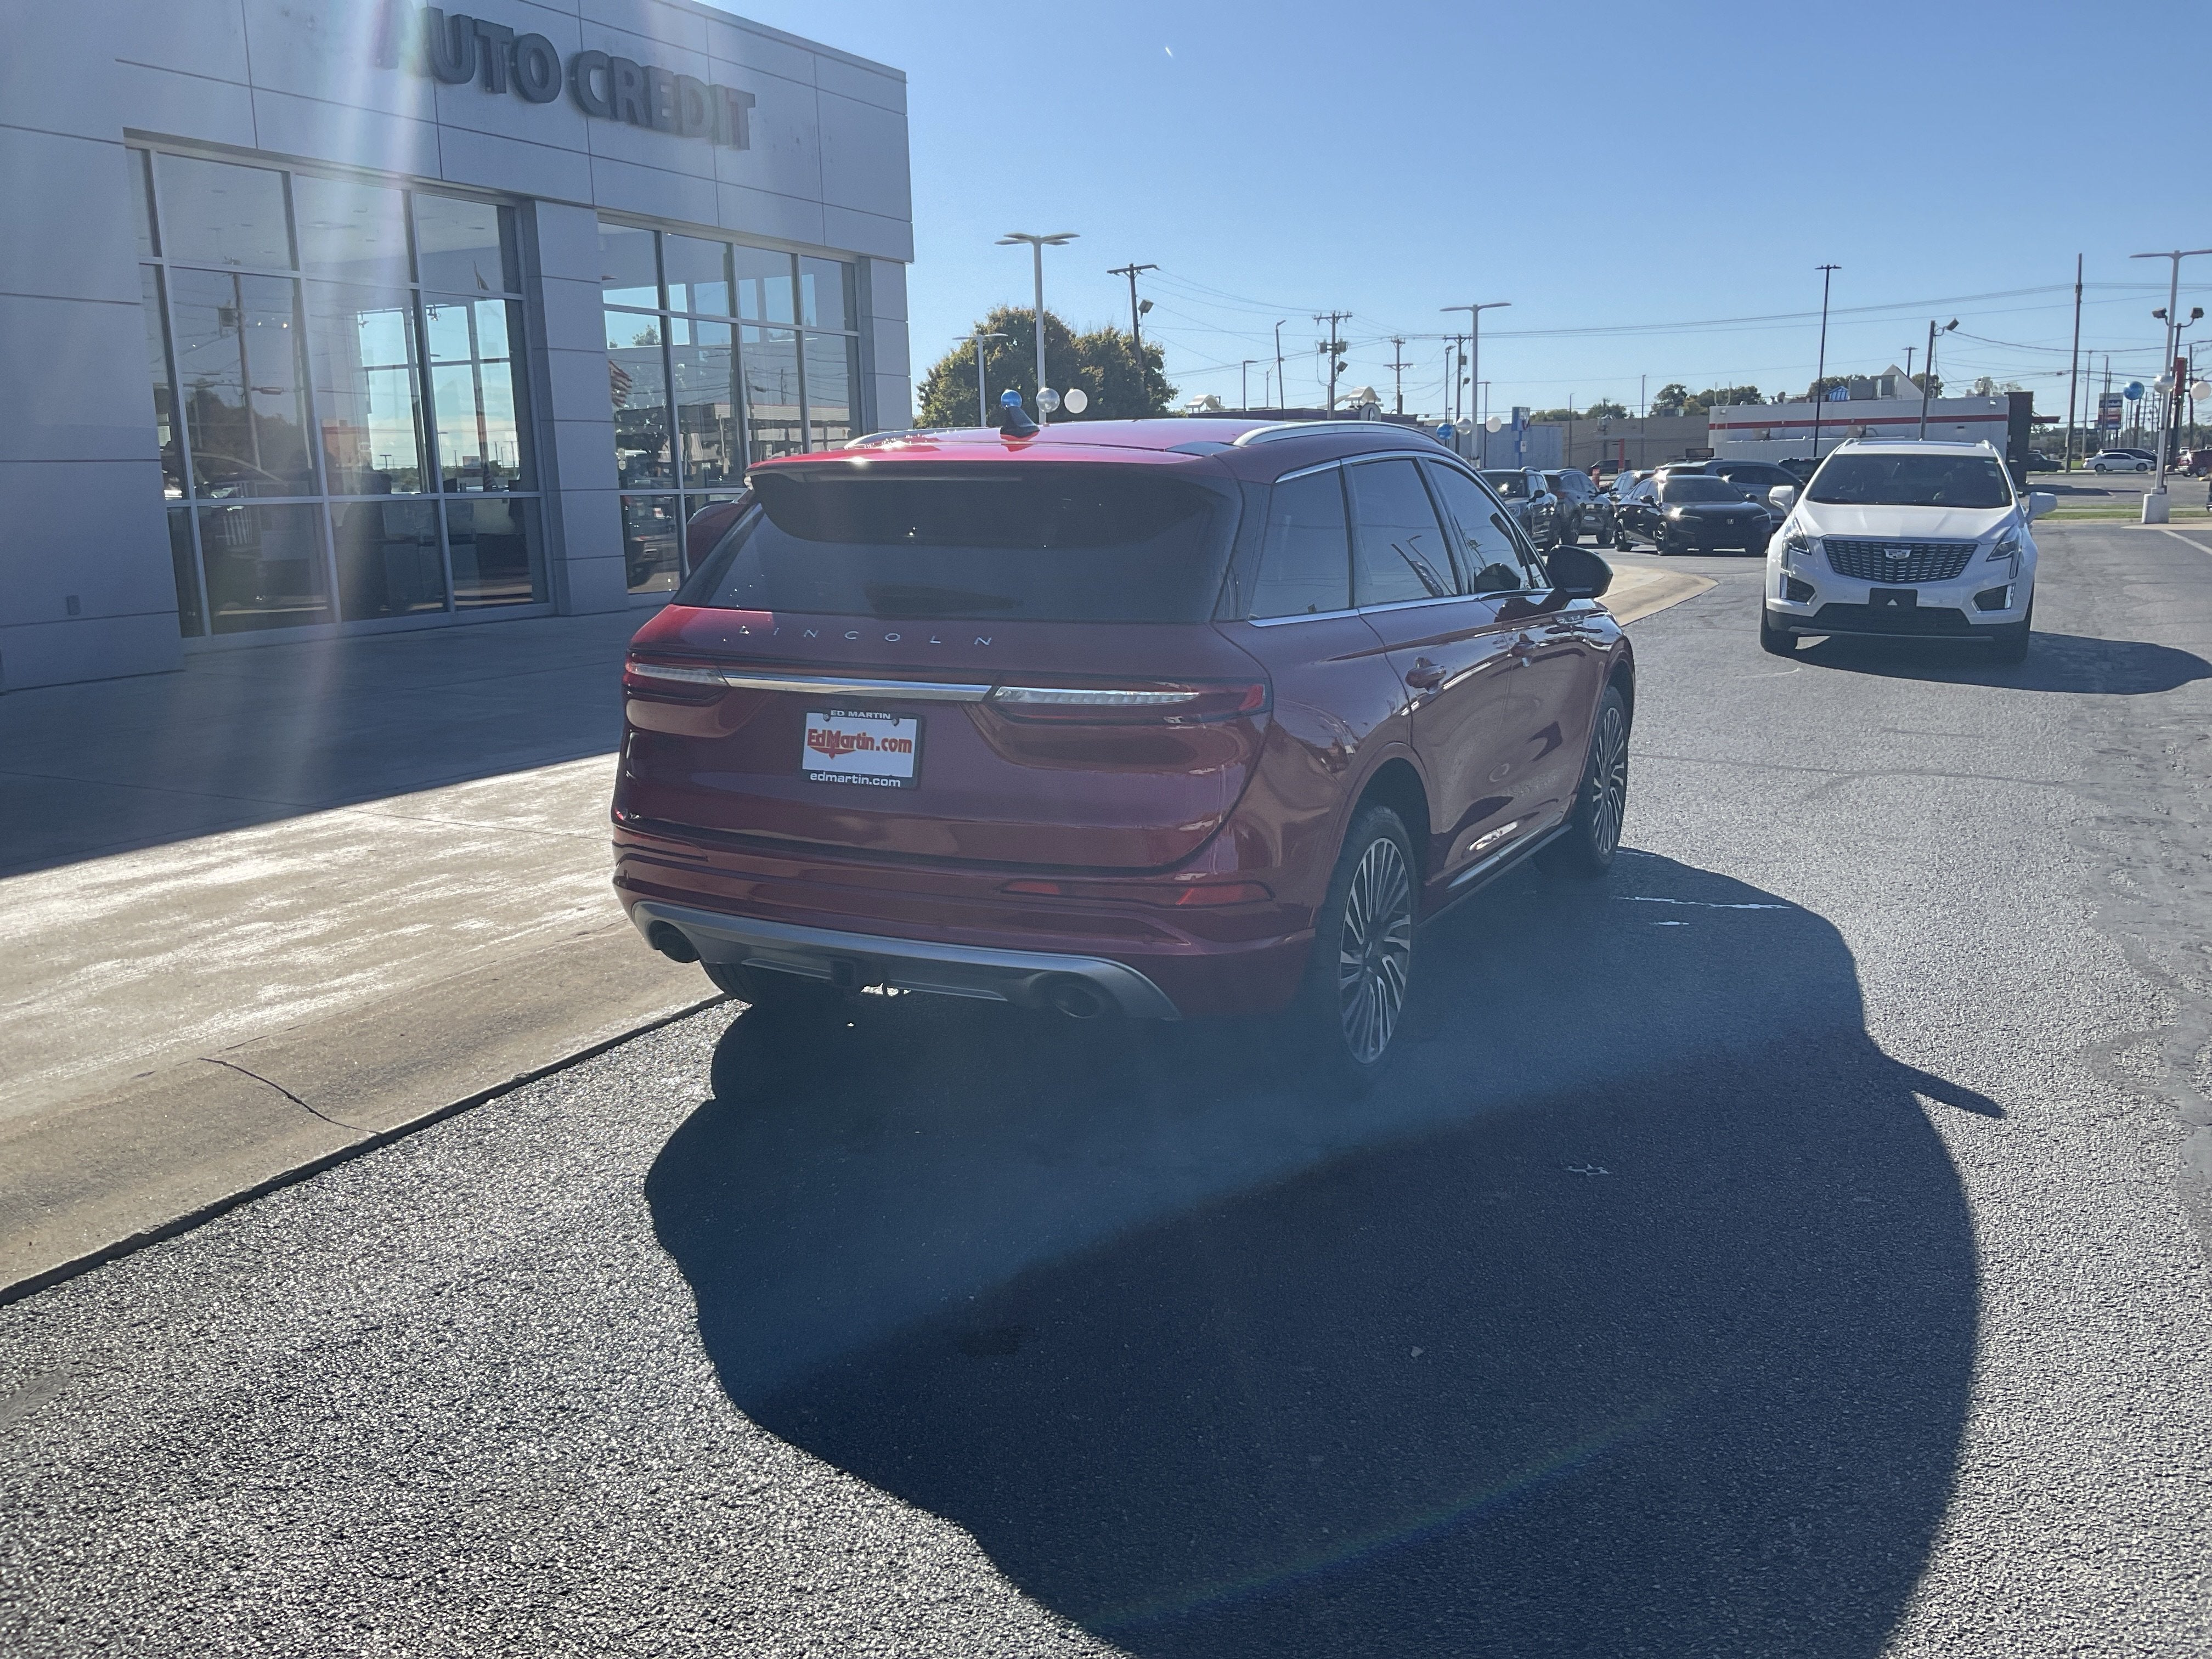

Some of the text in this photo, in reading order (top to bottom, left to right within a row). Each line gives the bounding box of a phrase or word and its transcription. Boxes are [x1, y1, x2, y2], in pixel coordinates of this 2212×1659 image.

[566, 49, 756, 150] CREDIT
[739, 625, 992, 646] LINCOLN
[848, 711, 891, 719] MARTIN
[807, 728, 912, 759] EdMartin.com
[810, 771, 901, 787] edmartin.com
